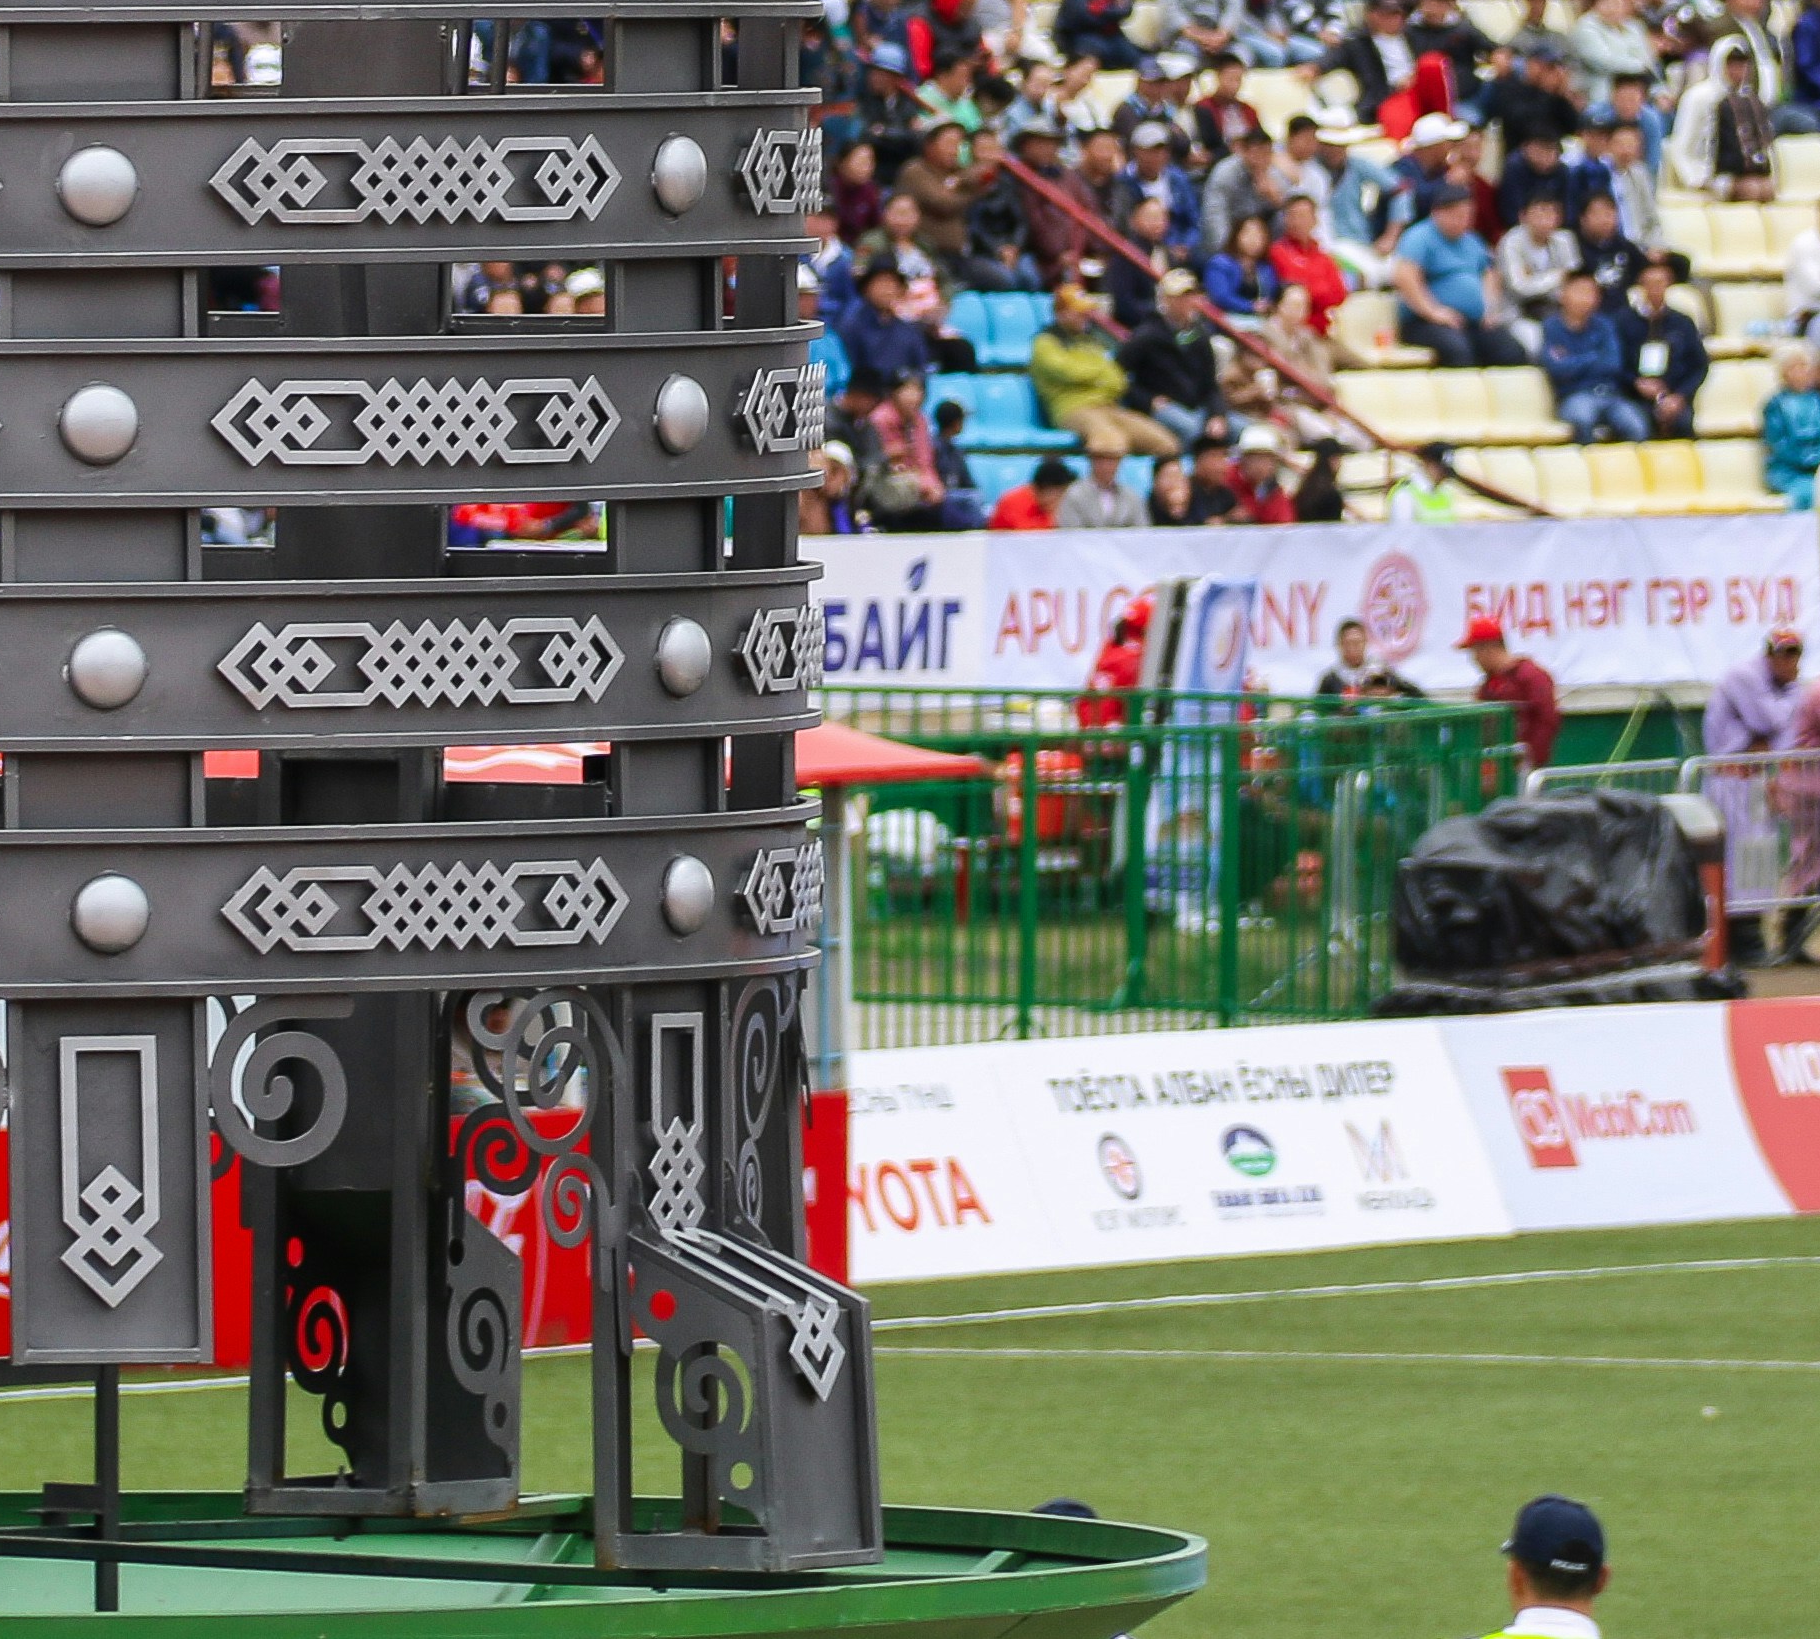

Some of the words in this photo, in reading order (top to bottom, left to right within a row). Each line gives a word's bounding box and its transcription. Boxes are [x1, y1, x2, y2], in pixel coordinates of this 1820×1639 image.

[993, 589, 1085, 655] APU
[1565, 579, 1631, 627] НЭГ
[1646, 577, 1713, 626] ГЭР
[847, 1157, 994, 1233] YOTA
